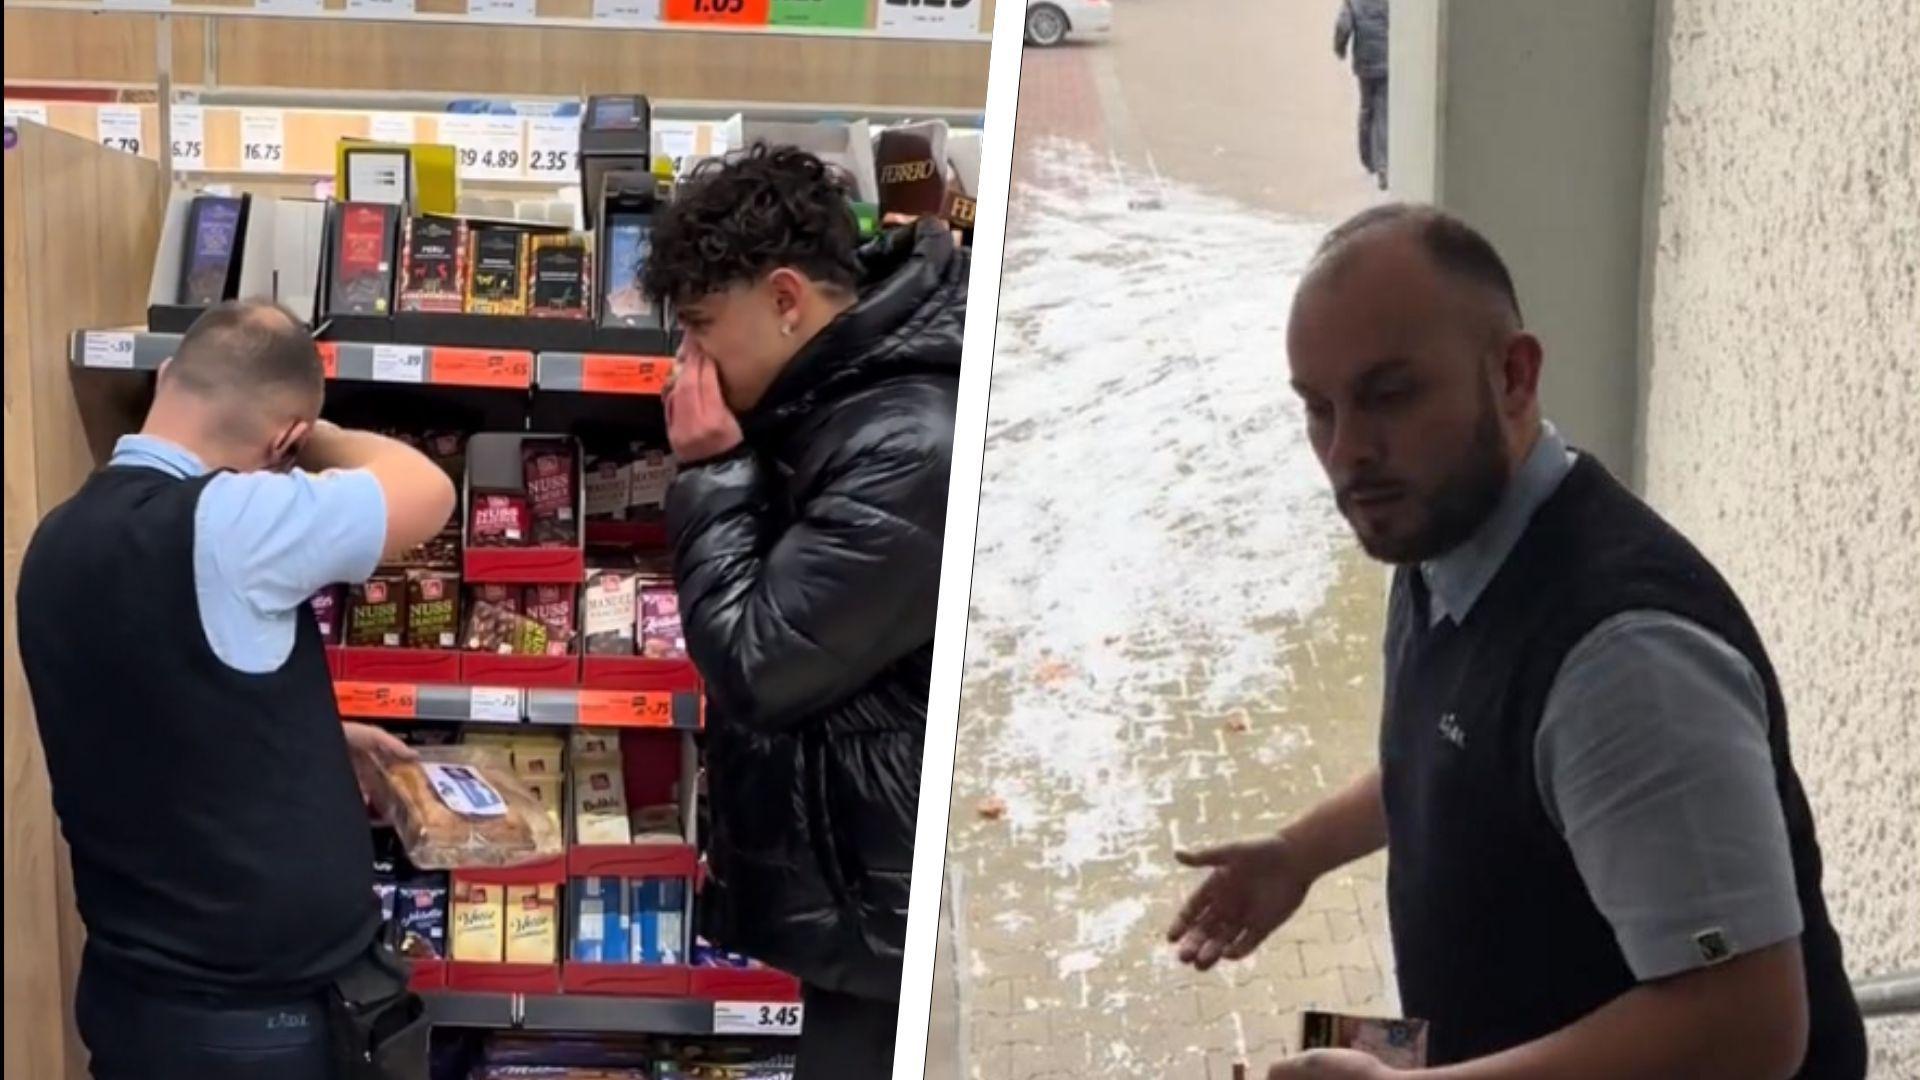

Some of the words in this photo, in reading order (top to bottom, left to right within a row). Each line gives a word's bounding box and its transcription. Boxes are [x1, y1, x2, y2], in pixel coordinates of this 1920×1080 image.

[244, 143, 281, 161] 16.75
[482, 151, 519, 168] 4.89
[530, 152, 567, 170] 2.35
[881, 159, 936, 183] FERRERO
[354, 603, 397, 620] NUSS
[410, 599, 452, 617] NUSS
[526, 601, 569, 619] NUSS
[758, 1006, 799, 1026] 3.45
